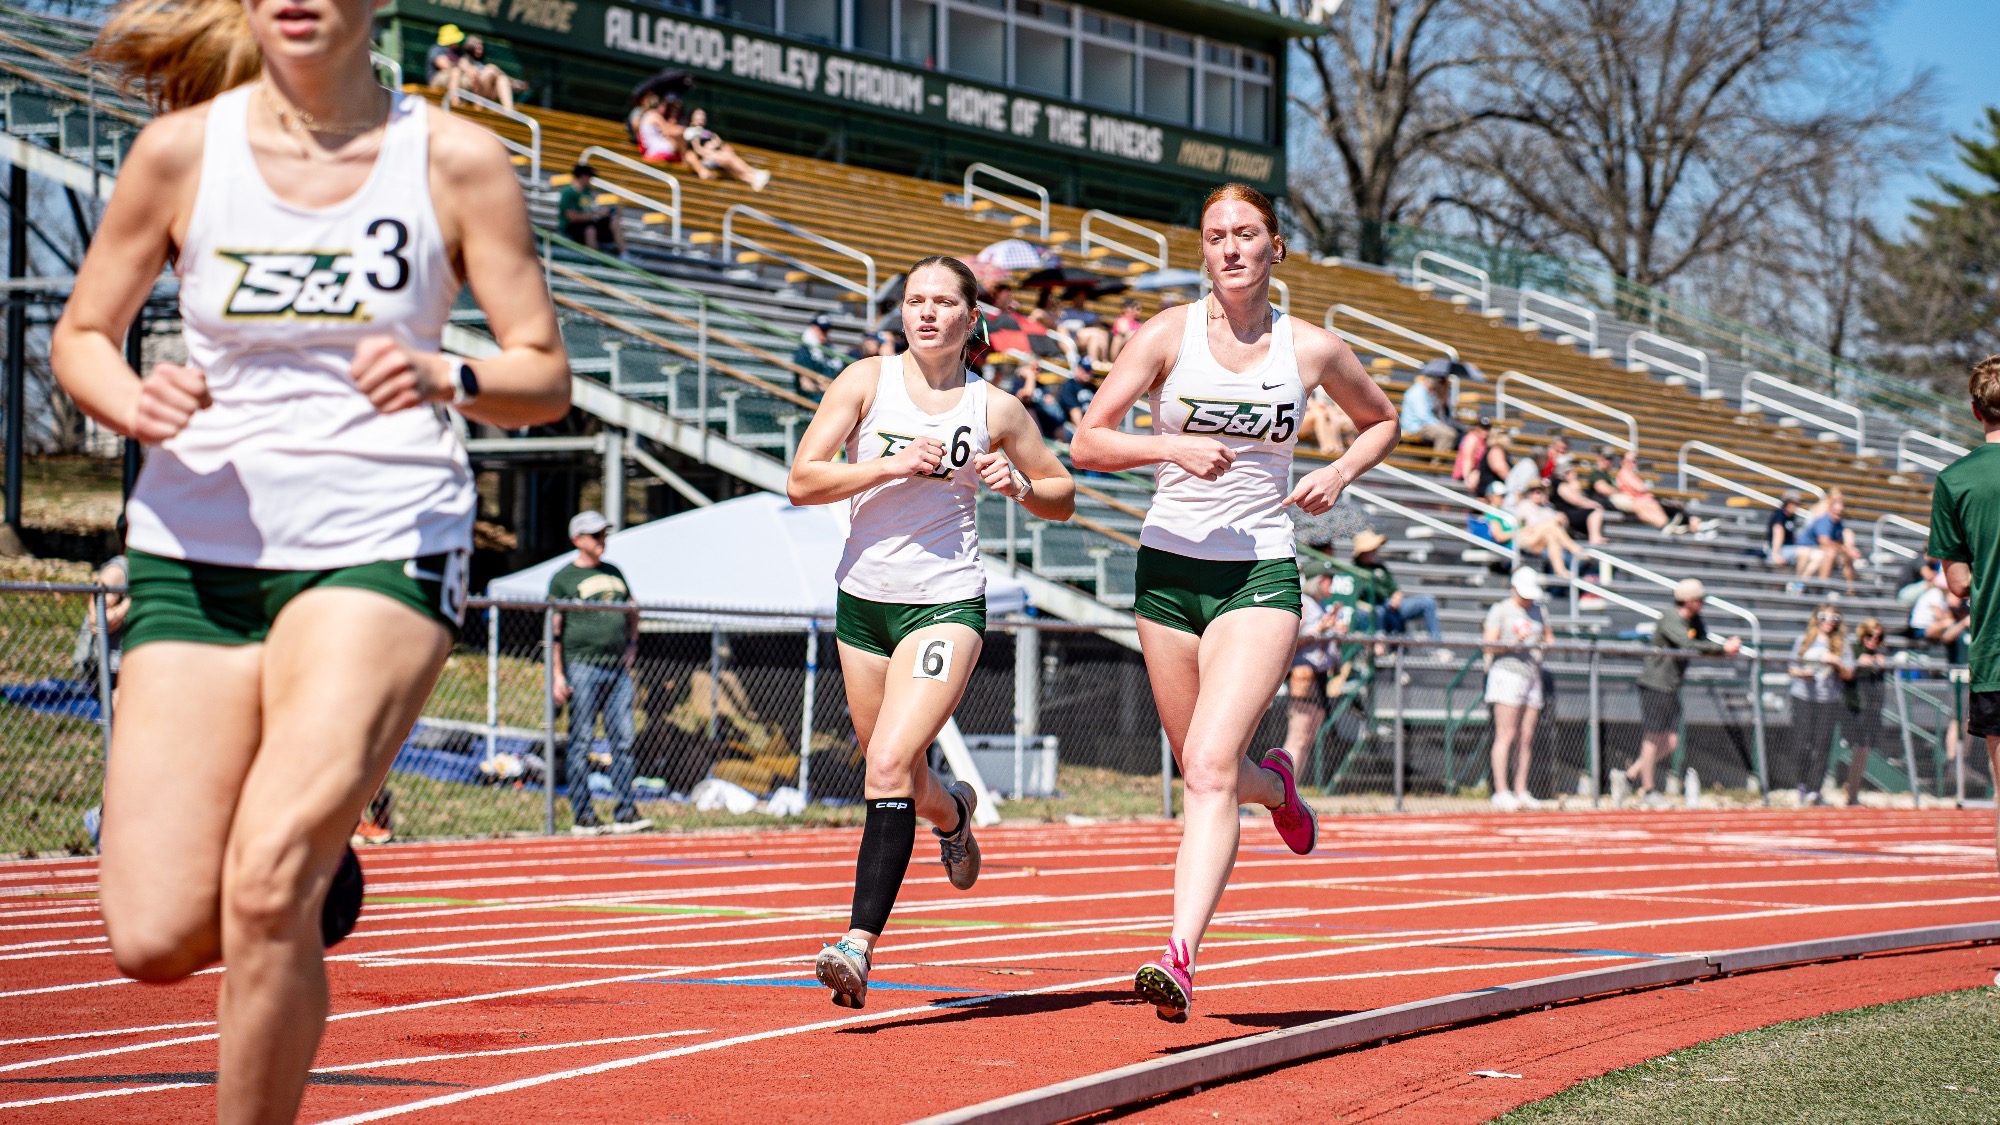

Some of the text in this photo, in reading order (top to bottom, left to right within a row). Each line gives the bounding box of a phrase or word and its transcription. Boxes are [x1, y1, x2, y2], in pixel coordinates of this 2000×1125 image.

[507, 0, 577, 33] PRIDE
[604, 5, 820, 92] ALLGOOD-BAILEY
[824, 55, 925, 114] STADIUM
[946, 82, 1008, 132] HOME
[1010, 97, 1042, 138] OF
[1045, 104, 1088, 149] THE
[1089, 113, 1164, 164] MINERS
[1177, 138, 1275, 184] MINER TOUGH
[366, 218, 409, 291] 3
[1183, 399, 1295, 443] S&T 5
[950, 425, 972, 468] 6
[922, 640, 946, 677] 6
